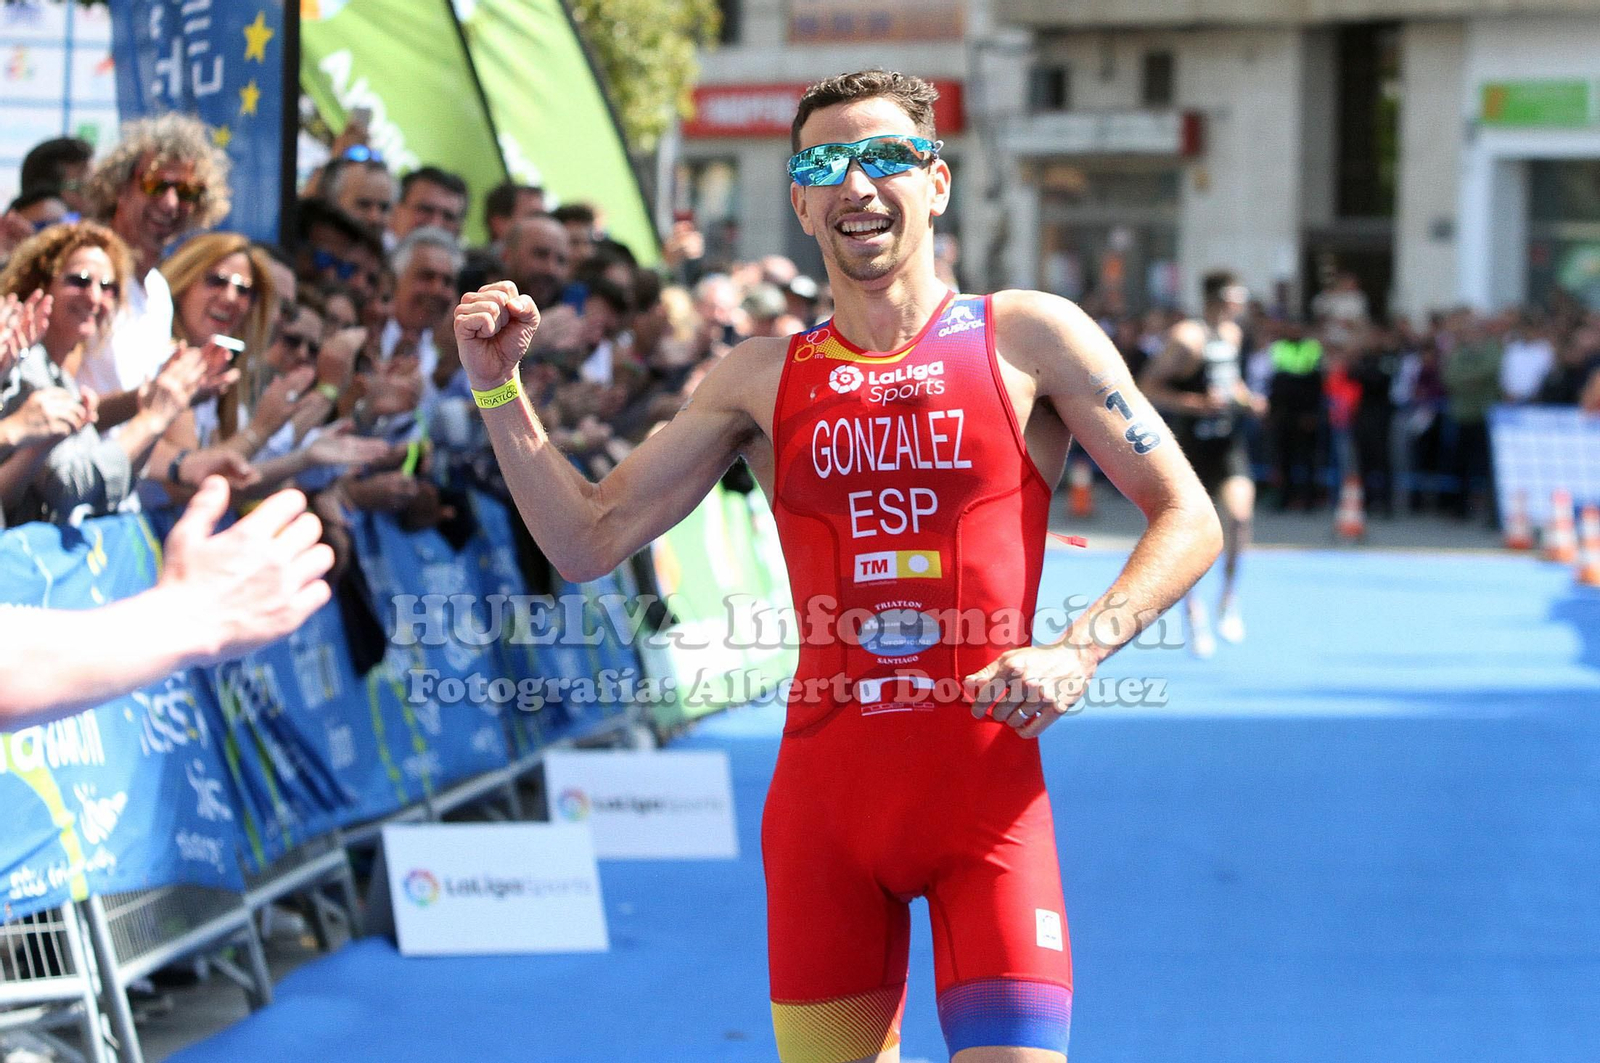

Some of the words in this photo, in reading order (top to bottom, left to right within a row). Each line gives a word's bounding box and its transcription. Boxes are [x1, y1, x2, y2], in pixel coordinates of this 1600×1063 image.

[868, 361, 944, 386] LaLiga
[868, 379, 945, 406] Sports
[812, 409, 973, 479] GONZALEZ
[848, 487, 938, 539] ESP
[860, 558, 888, 576] TM
[874, 600, 922, 612] TRIATLON
[876, 655, 919, 664] SANTIAGO
